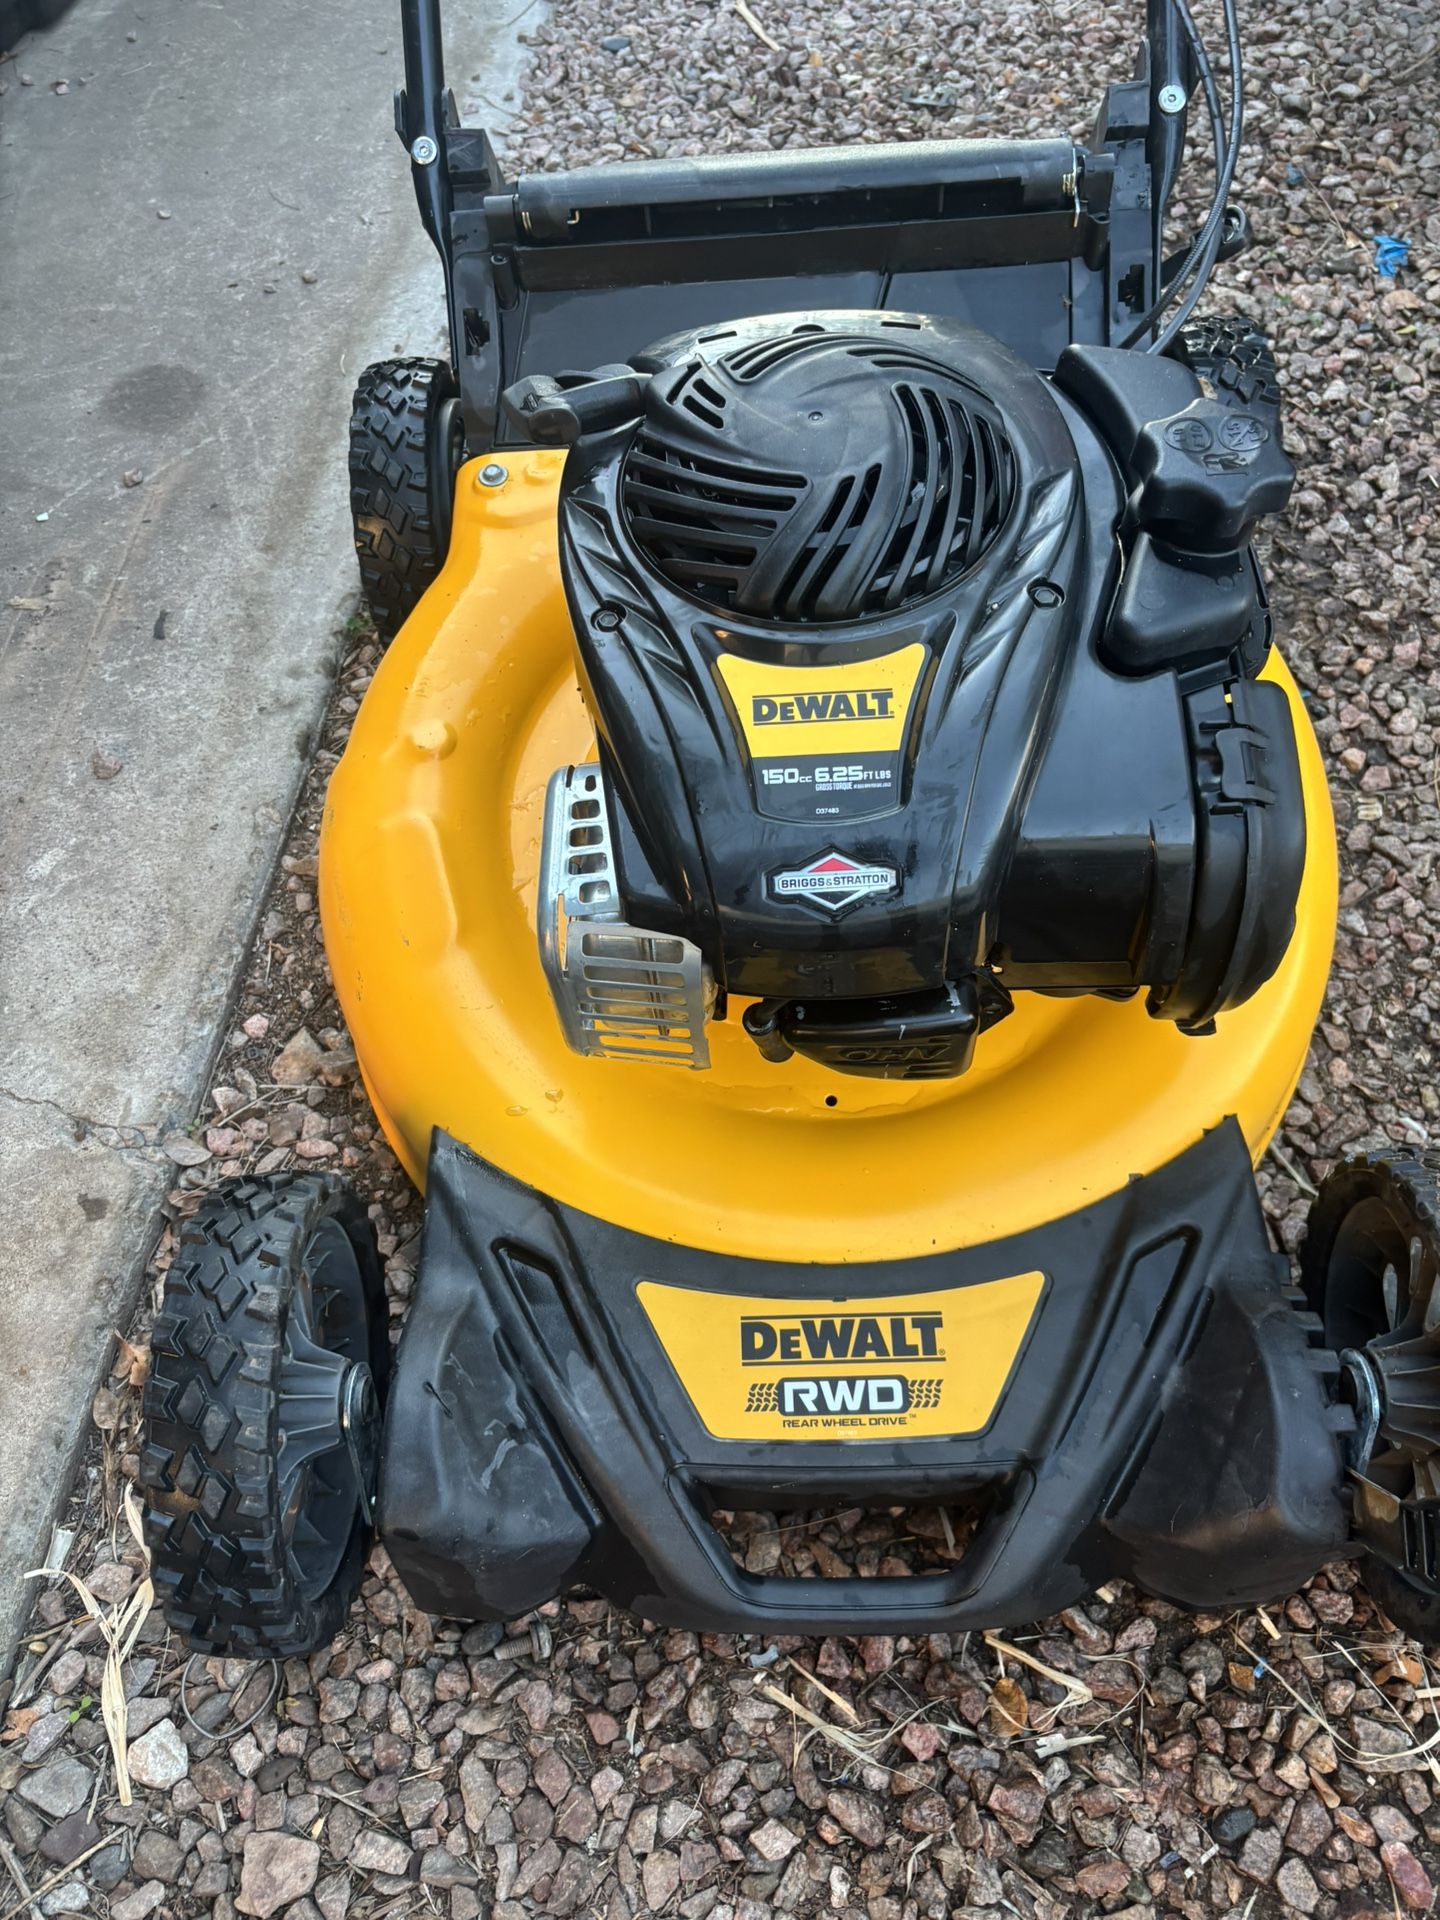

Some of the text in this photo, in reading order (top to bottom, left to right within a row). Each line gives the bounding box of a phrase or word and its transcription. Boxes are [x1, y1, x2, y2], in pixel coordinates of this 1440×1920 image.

[783, 1378, 904, 1413] RWD
[782, 1416, 907, 1428] REAR WHEEL DRIVE
